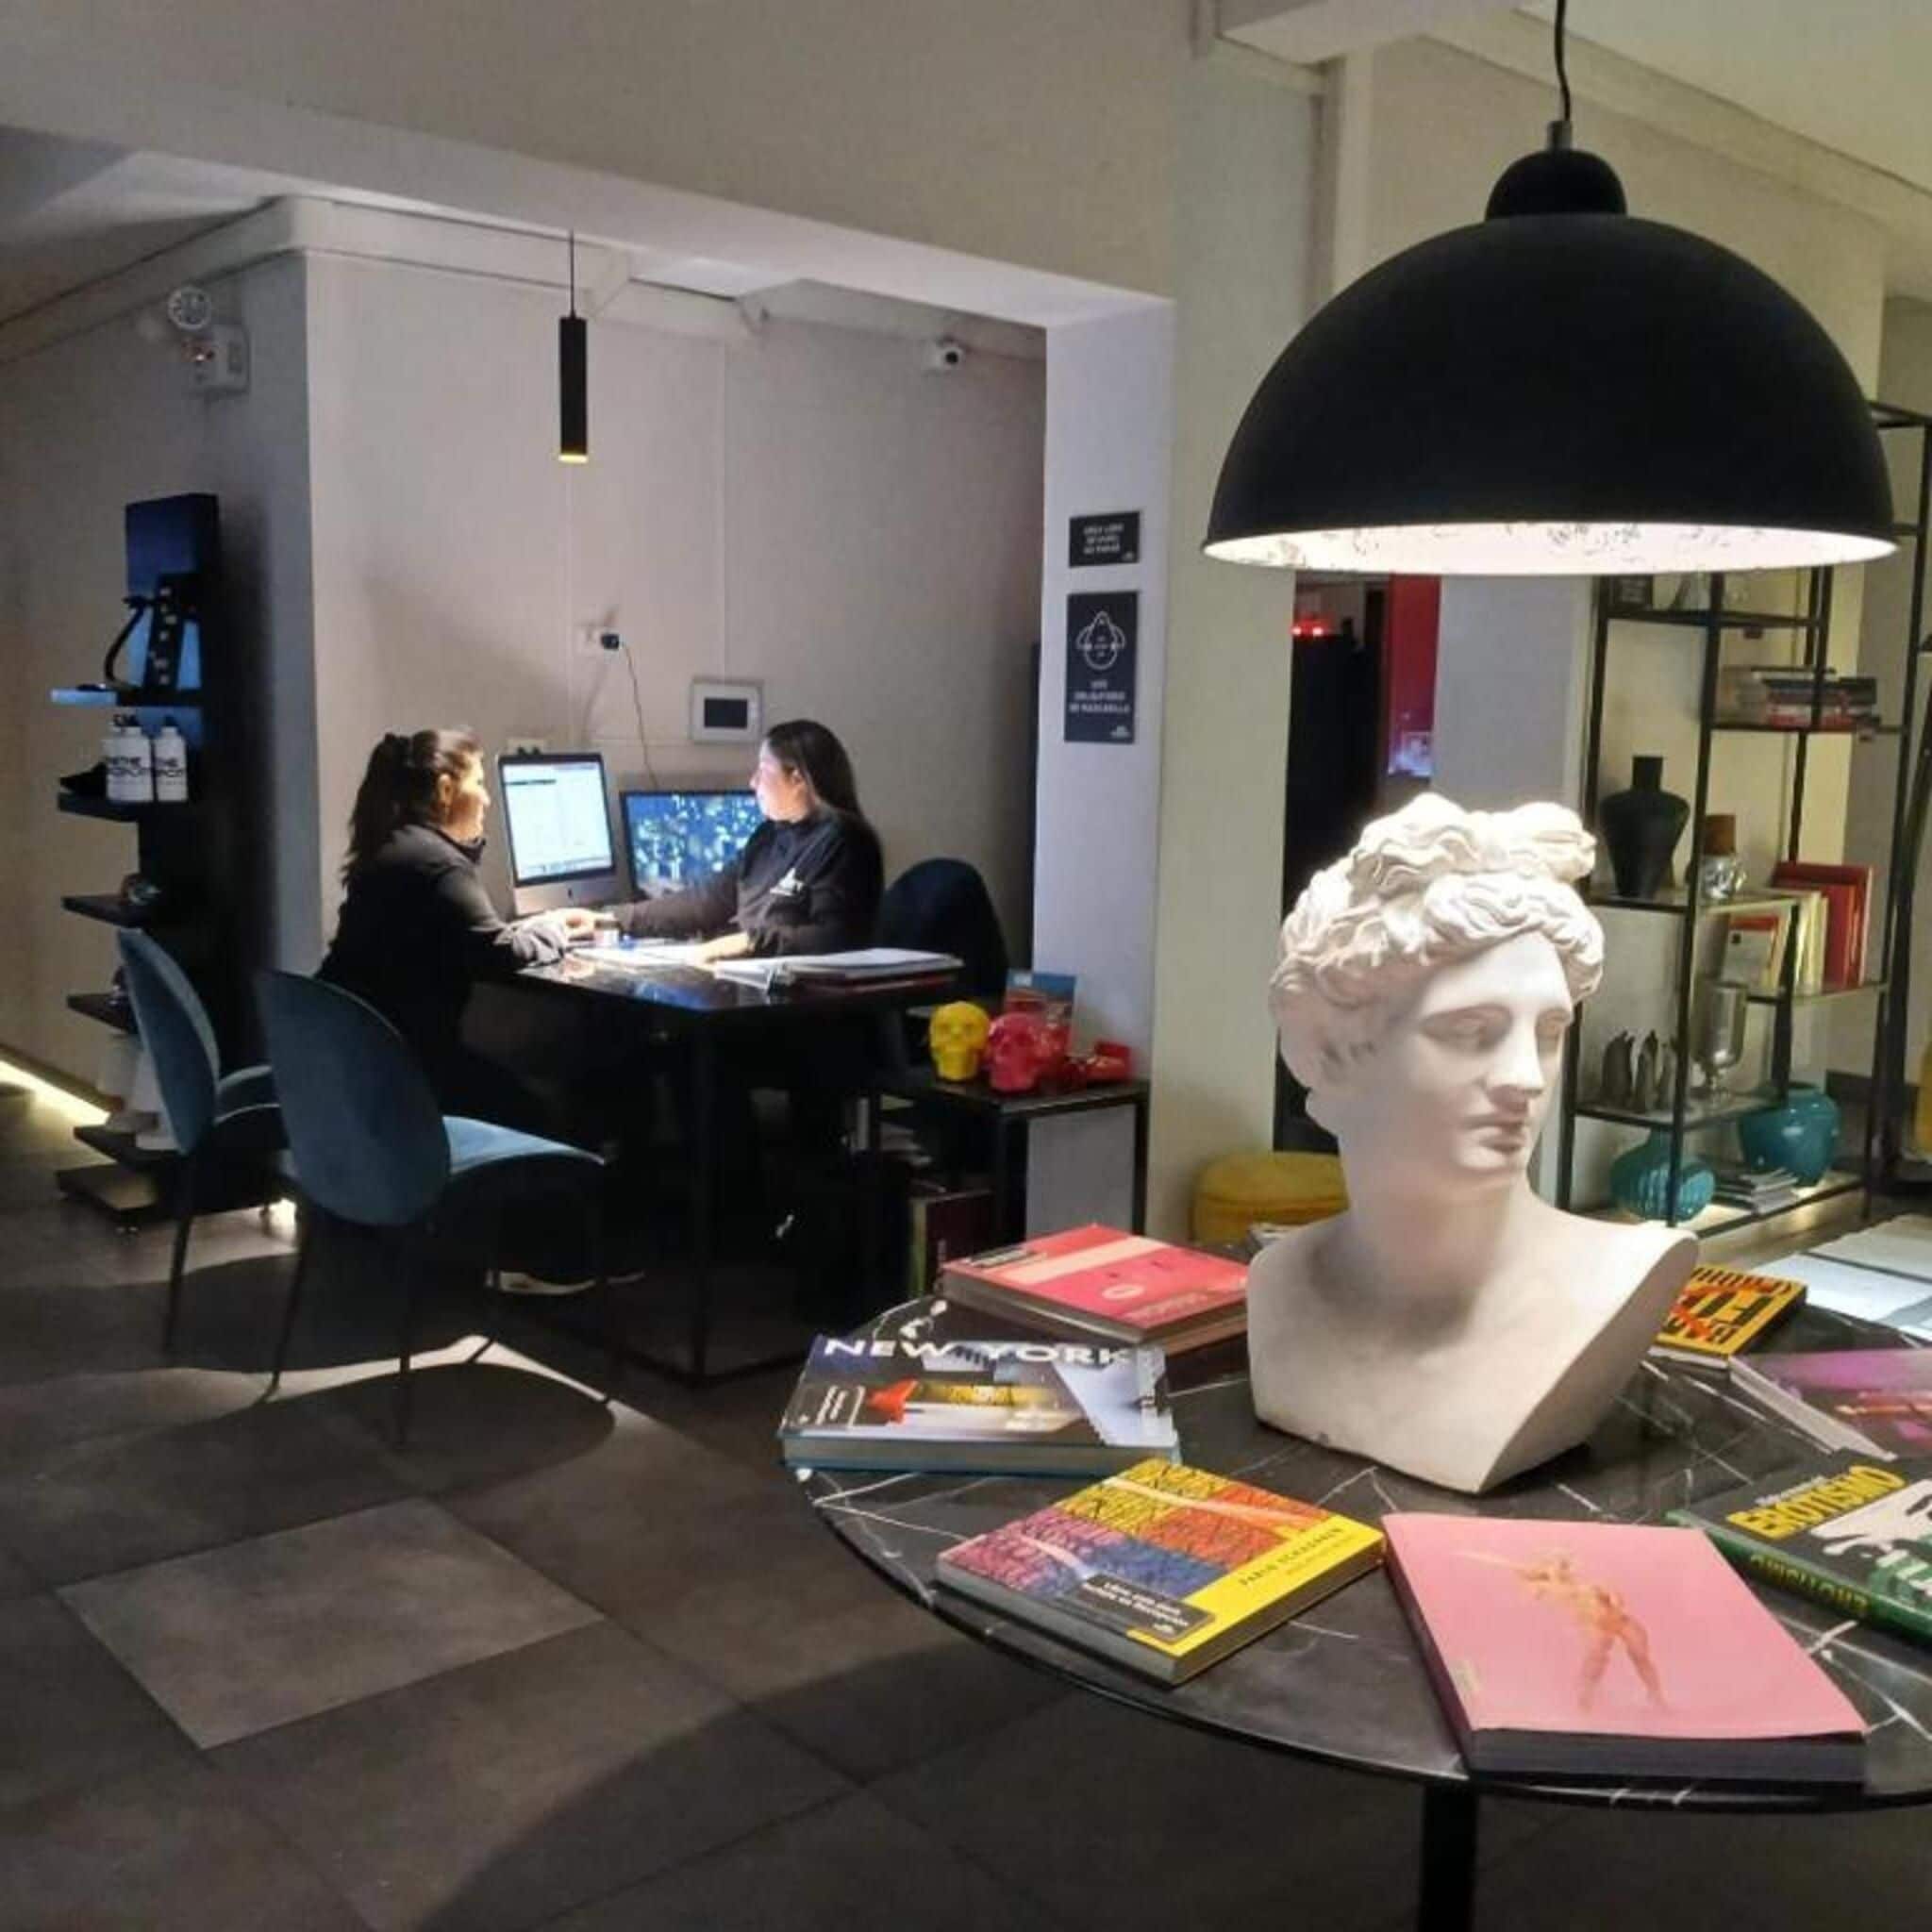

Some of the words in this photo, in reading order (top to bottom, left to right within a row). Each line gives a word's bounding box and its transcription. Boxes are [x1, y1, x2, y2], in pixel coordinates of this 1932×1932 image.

[824, 1339, 957, 1357] NEW
[978, 1342, 1132, 1365] YORK
[1725, 1464, 1906, 1541] EROTISMO
